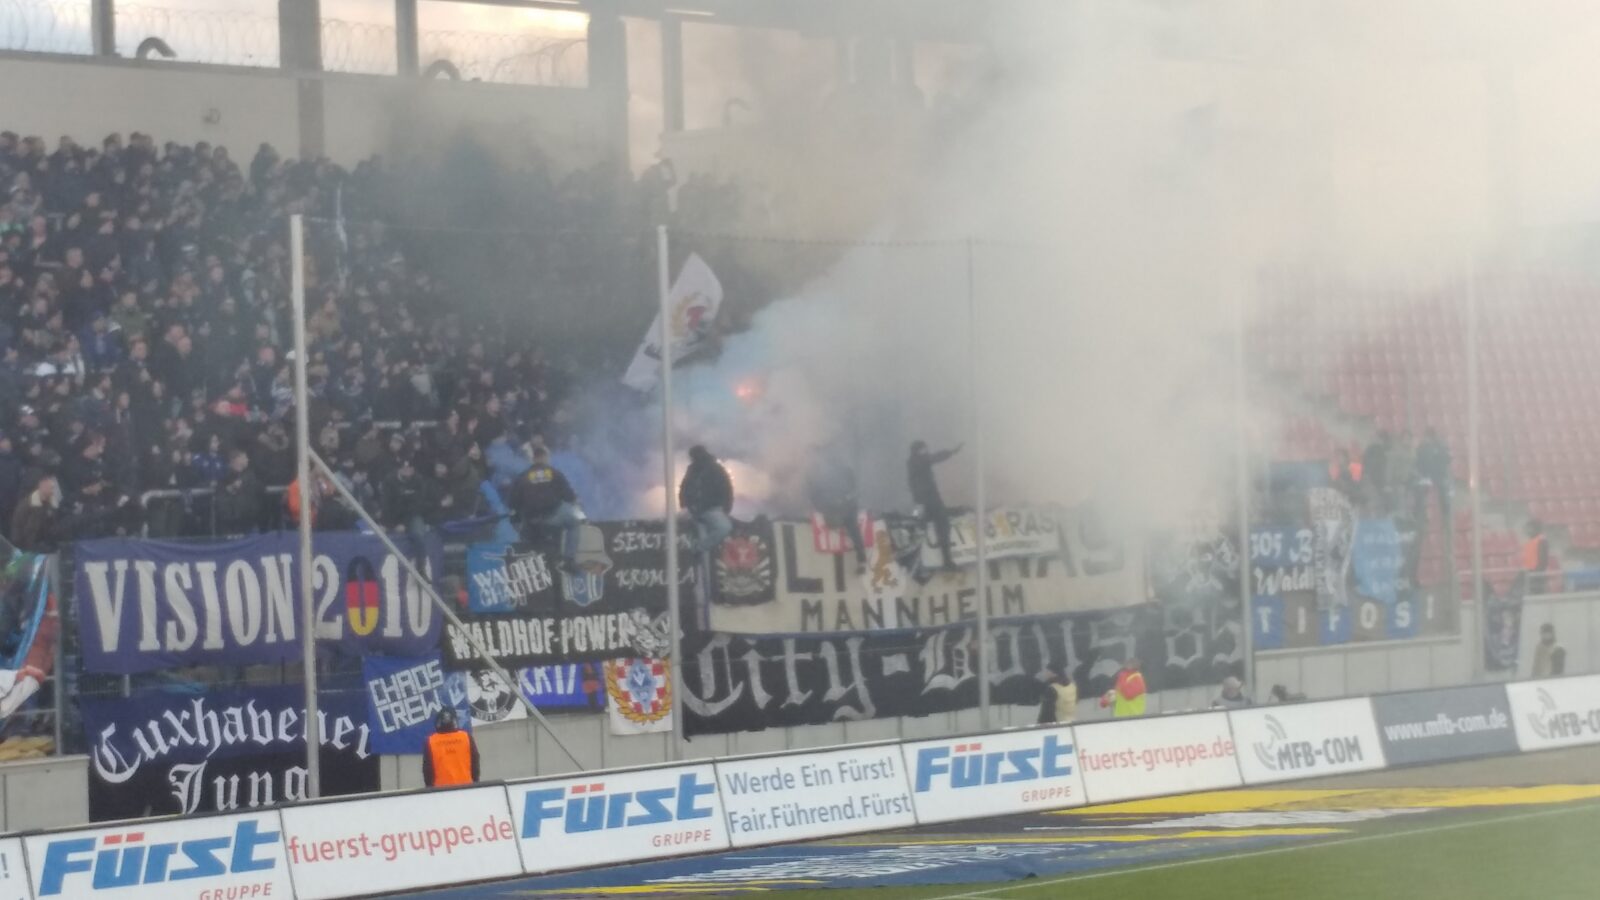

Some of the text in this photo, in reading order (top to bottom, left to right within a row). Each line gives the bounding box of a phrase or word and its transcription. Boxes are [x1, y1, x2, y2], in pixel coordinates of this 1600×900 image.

[84, 553, 433, 652] VISION 2010
[801, 583, 1025, 632] MANNHEIM
[368, 658, 444, 706] CHAOS
[375, 693, 444, 734] CREW
[1385, 709, 1508, 742] www.mfb-com.de
[915, 735, 1073, 793] Fürst
[1079, 736, 1235, 772] fuerst-gruppe.de
[1277, 736, 1364, 772] MFB-COM
[725, 756, 896, 796] Werde Ein Fürst!
[1021, 785, 1072, 803] GRUPPE
[521, 772, 717, 840] Fürst
[728, 792, 912, 834] Fair.Führend.Fürst
[39, 820, 281, 897] Fürst
[288, 814, 513, 864] fuerst-gruppe.de
[652, 828, 712, 849] GRUPPE
[199, 882, 273, 900] GRUPPE
